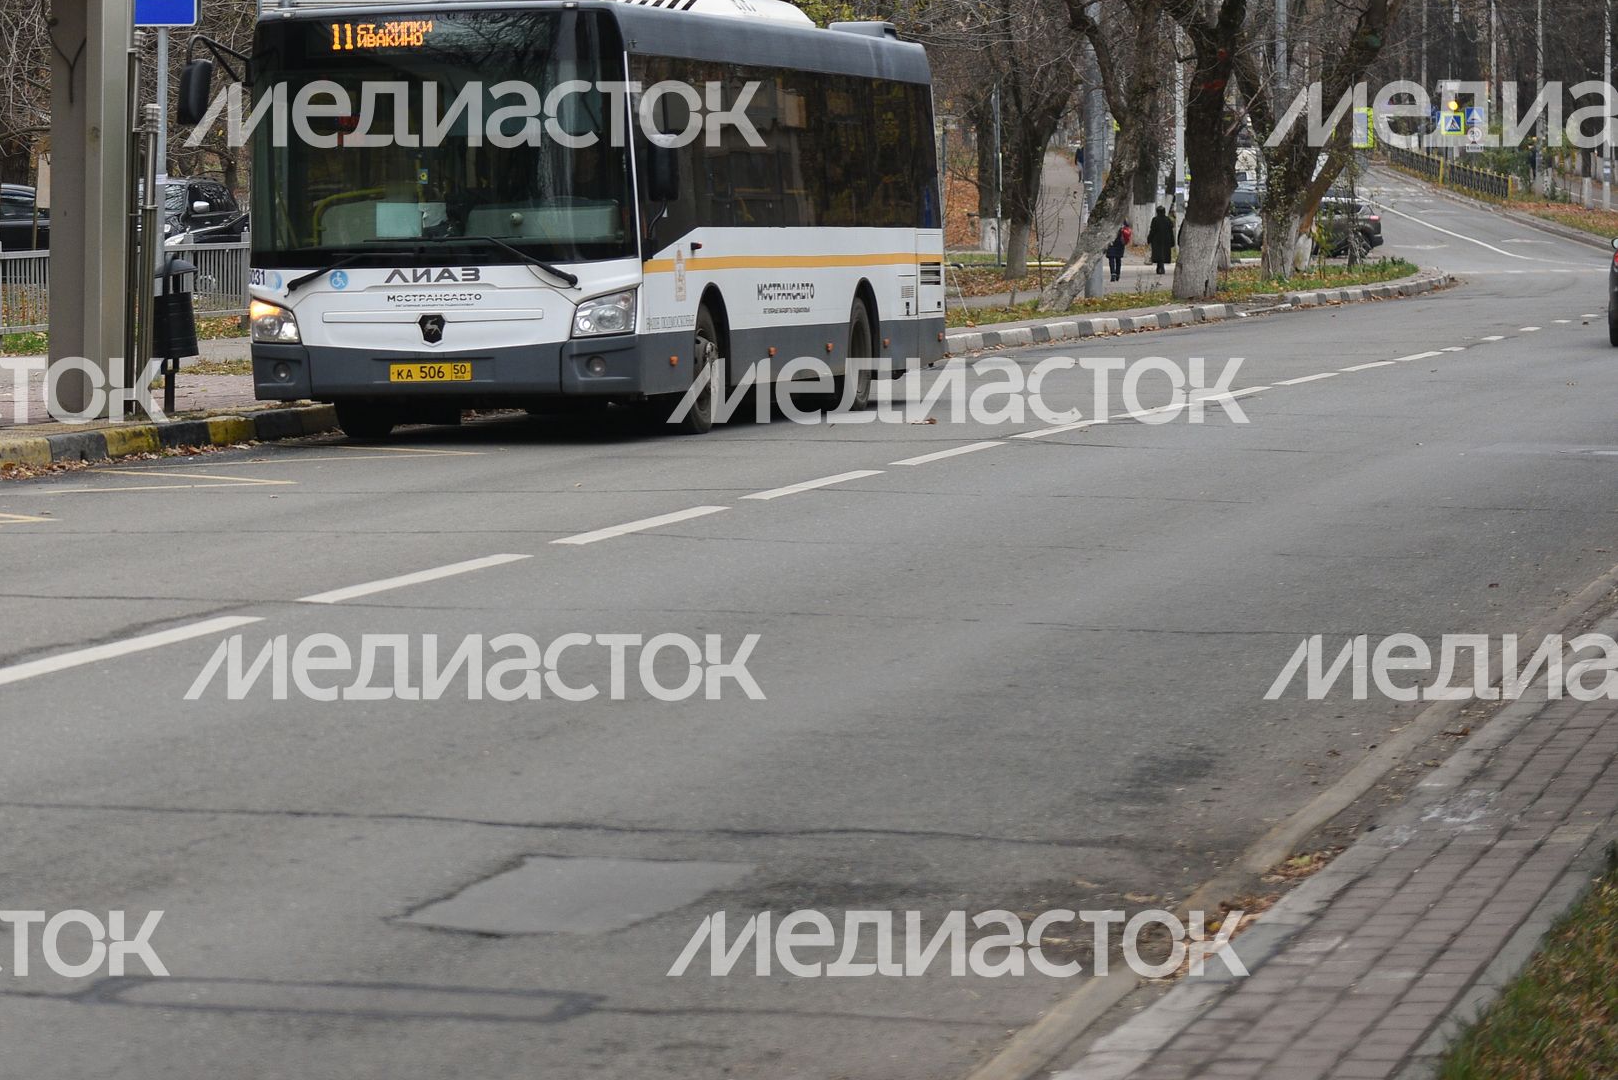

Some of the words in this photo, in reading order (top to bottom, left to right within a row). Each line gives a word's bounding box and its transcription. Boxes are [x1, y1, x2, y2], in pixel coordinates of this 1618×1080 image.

[332, 23, 354, 50] 11
[356, 32, 424, 48] ИВАКИНО
[384, 267, 481, 284] ЛИАЗ
[387, 293, 482, 302] МОСТРАНСАВТО
[757, 282, 815, 301] МОСТРАНСАВТО
[419, 365, 445, 379] 506
[453, 364, 467, 375] 50
